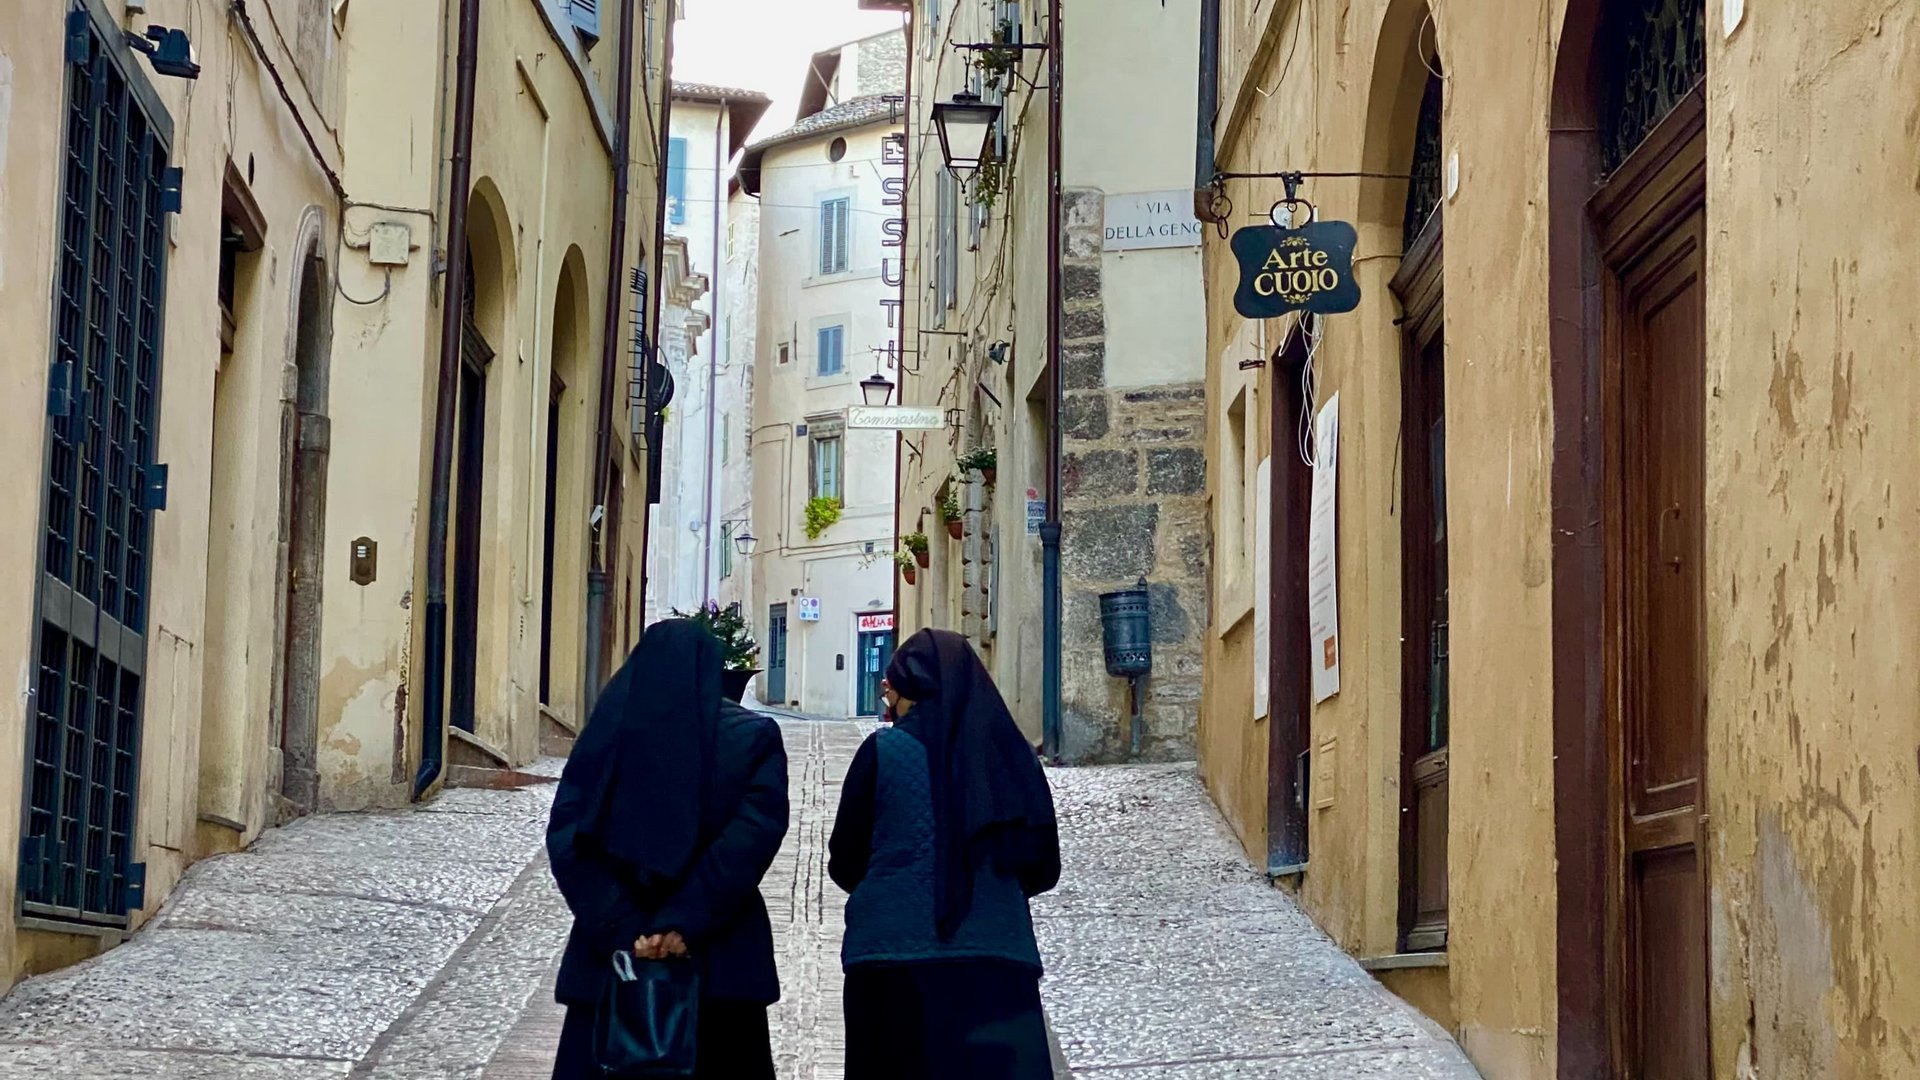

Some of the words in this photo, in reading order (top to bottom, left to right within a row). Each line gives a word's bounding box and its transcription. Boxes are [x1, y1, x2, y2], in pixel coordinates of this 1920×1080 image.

[1146, 202, 1172, 214] VIA
[879, 95, 906, 369] TESSUTI
[1105, 225, 1155, 240] DELLA
[1261, 247, 1329, 270] Arte
[1253, 267, 1339, 297] CUOIO
